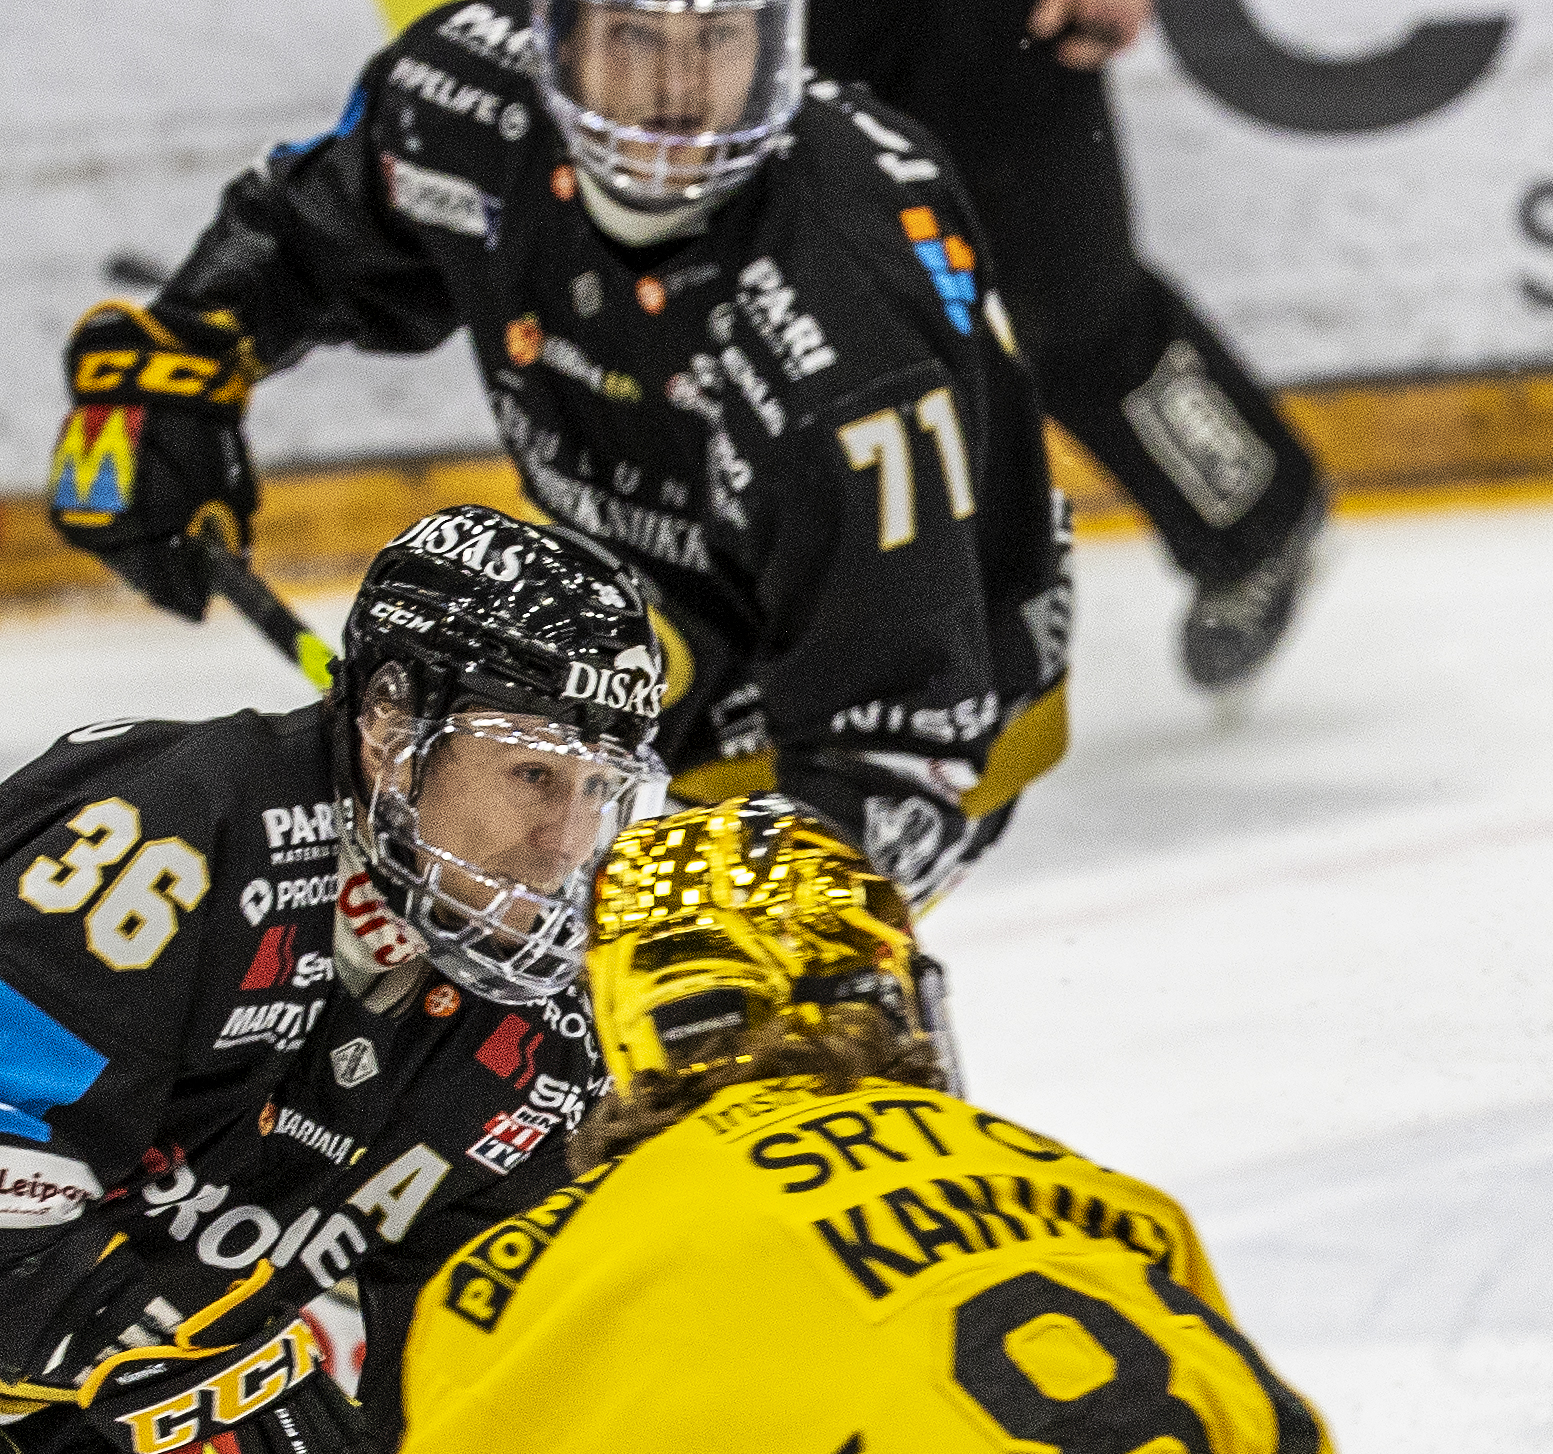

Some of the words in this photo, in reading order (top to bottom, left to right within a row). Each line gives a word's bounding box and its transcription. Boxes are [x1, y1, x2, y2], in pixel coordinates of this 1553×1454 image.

[836, 385, 977, 553] 71
[562, 659, 669, 720] DISAS
[16, 797, 211, 973] 36
[348, 1142, 453, 1242] A
[749, 1097, 952, 1194] SRT
